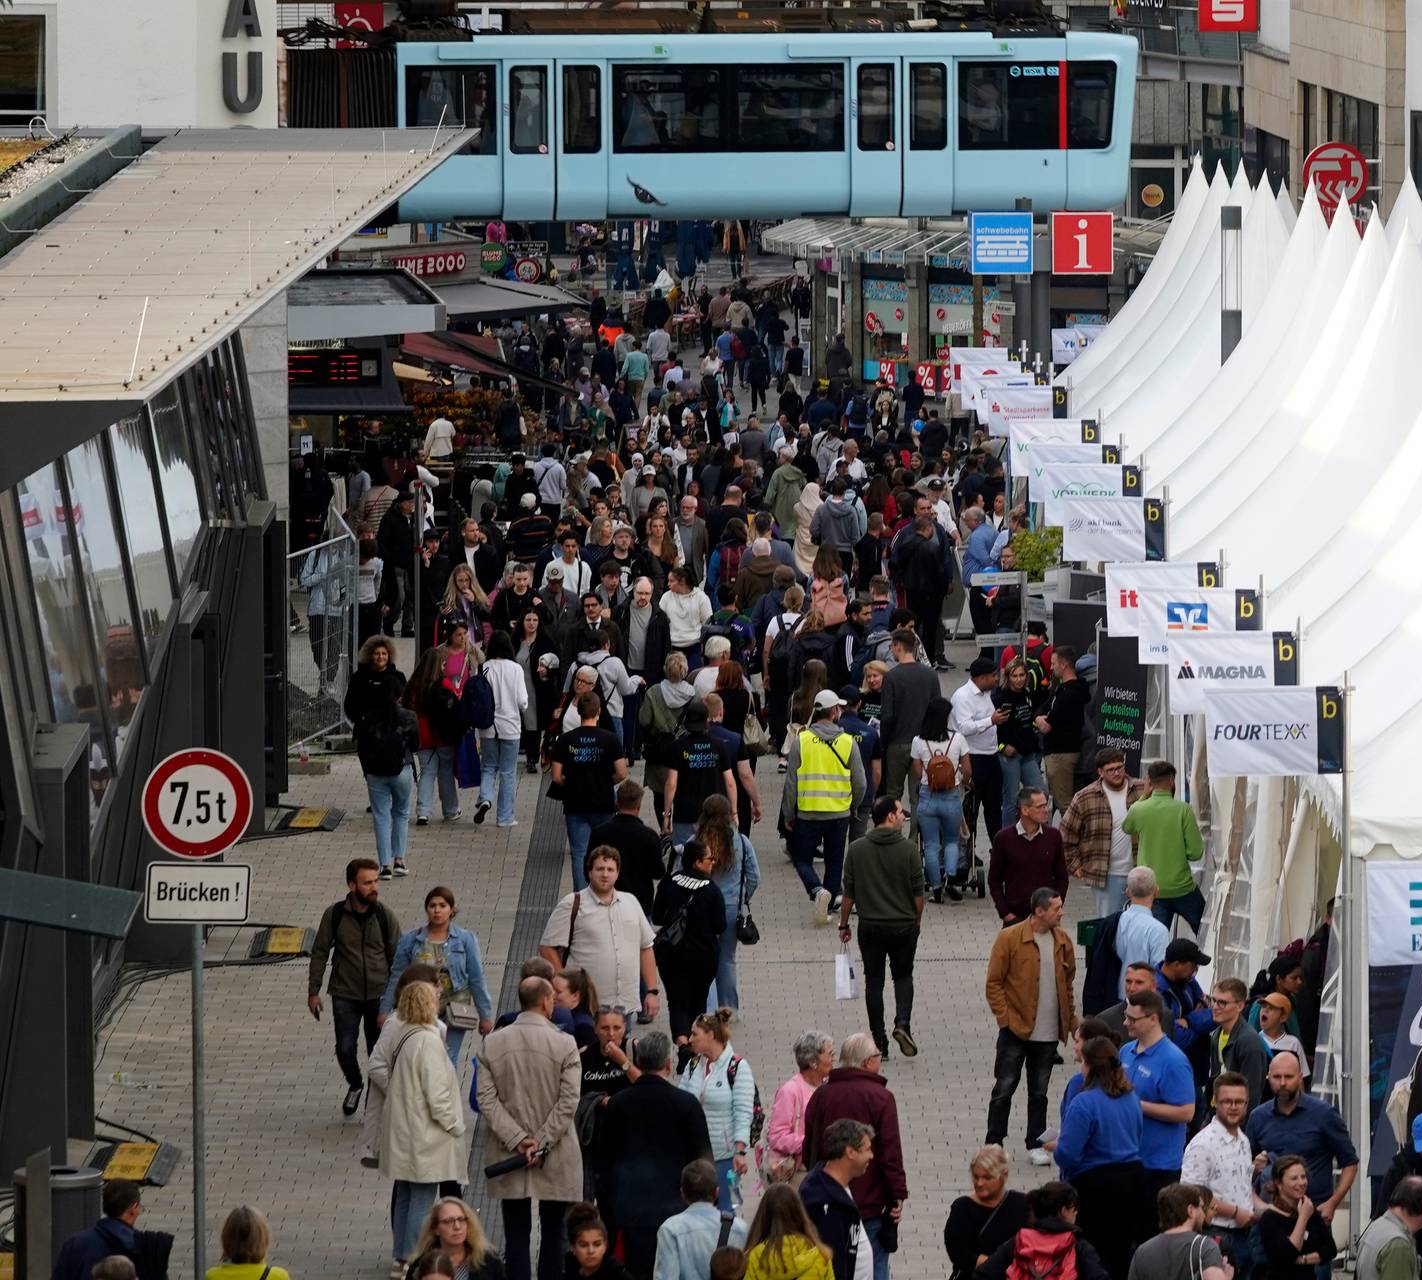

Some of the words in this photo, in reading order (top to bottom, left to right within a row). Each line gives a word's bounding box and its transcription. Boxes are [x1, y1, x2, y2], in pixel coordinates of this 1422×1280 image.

[427, 254, 466, 274] 2000
[1055, 391, 1065, 404] b
[1085, 424, 1095, 440] b
[1126, 470, 1137, 487] b
[1148, 504, 1160, 521] b
[1202, 569, 1215, 588] b
[1120, 589, 1138, 608] it
[1240, 596, 1254, 618] b
[1278, 639, 1294, 661] b
[1198, 665, 1266, 679] MAGNA
[1100, 702, 1111, 714] die
[1322, 694, 1337, 719] b
[1097, 733, 1105, 744] im
[1106, 735, 1141, 750] Bergischen
[156, 881, 230, 901] Brücken
[584, 1071, 610, 1080] Calvin
